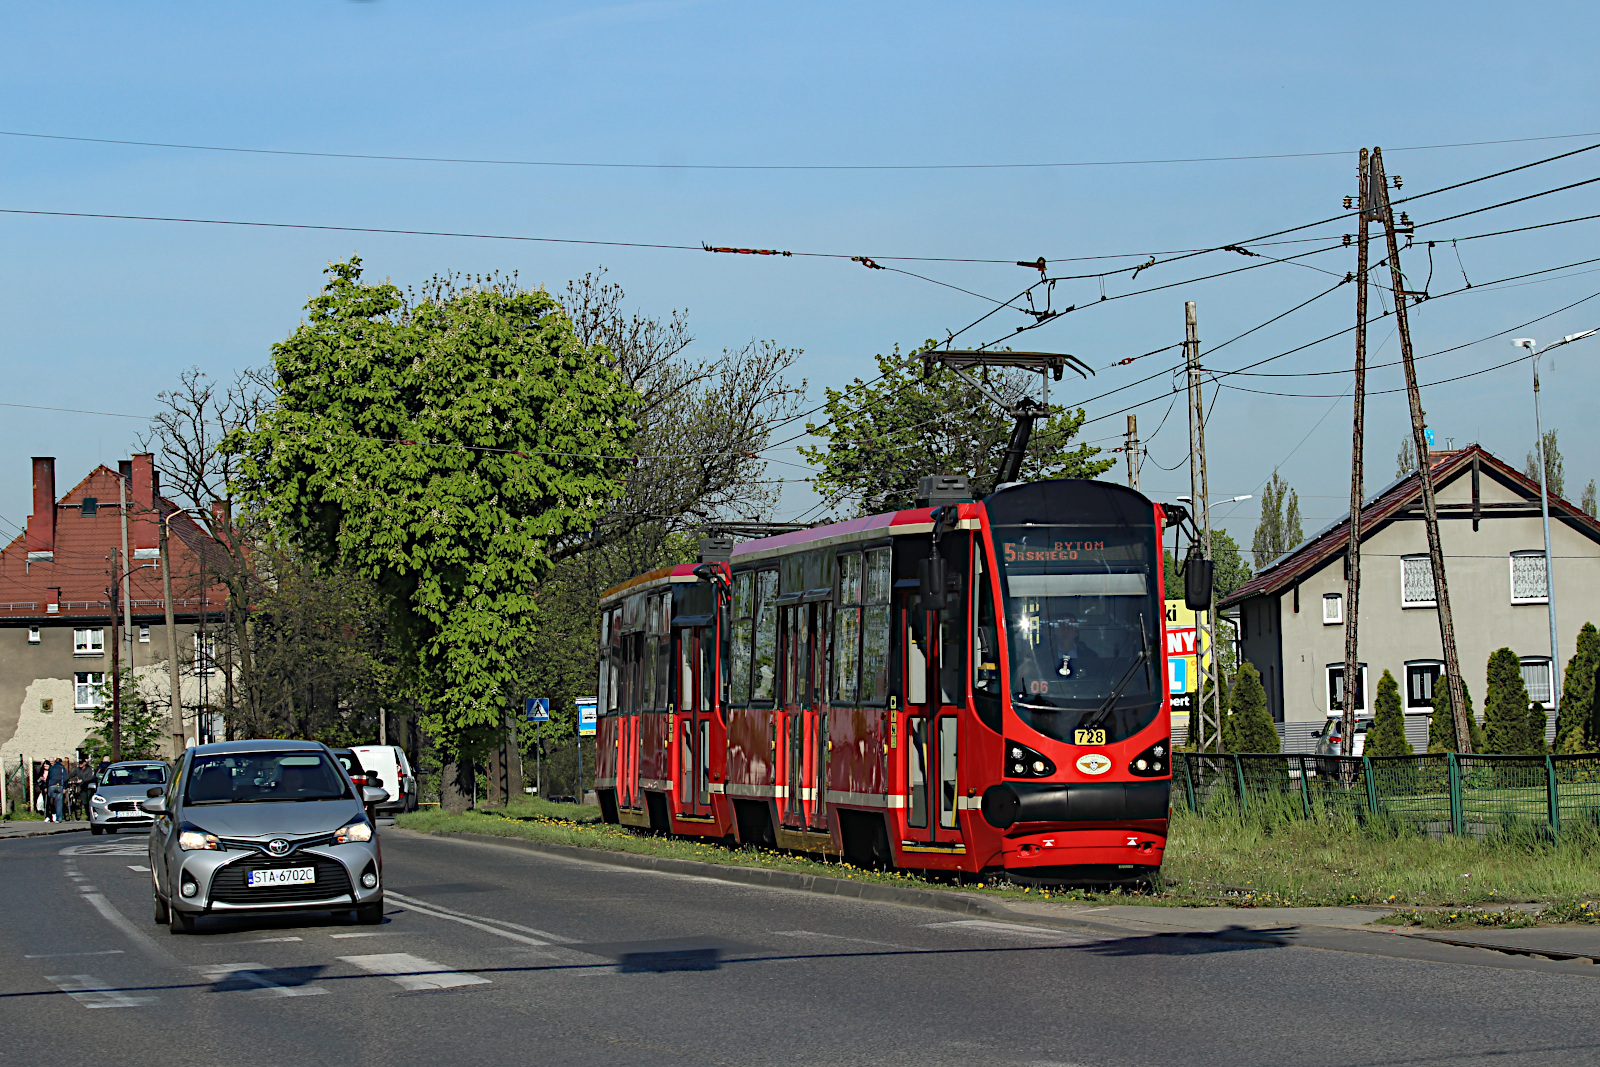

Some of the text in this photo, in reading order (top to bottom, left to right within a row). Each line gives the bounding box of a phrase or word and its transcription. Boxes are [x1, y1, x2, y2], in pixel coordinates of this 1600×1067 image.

[1004, 542, 1017, 562] 5
[1054, 541, 1104, 551] BYTOM
[1031, 680, 1049, 694] 06
[1077, 731, 1104, 743] 728
[254, 869, 313, 883] STA 6702C
